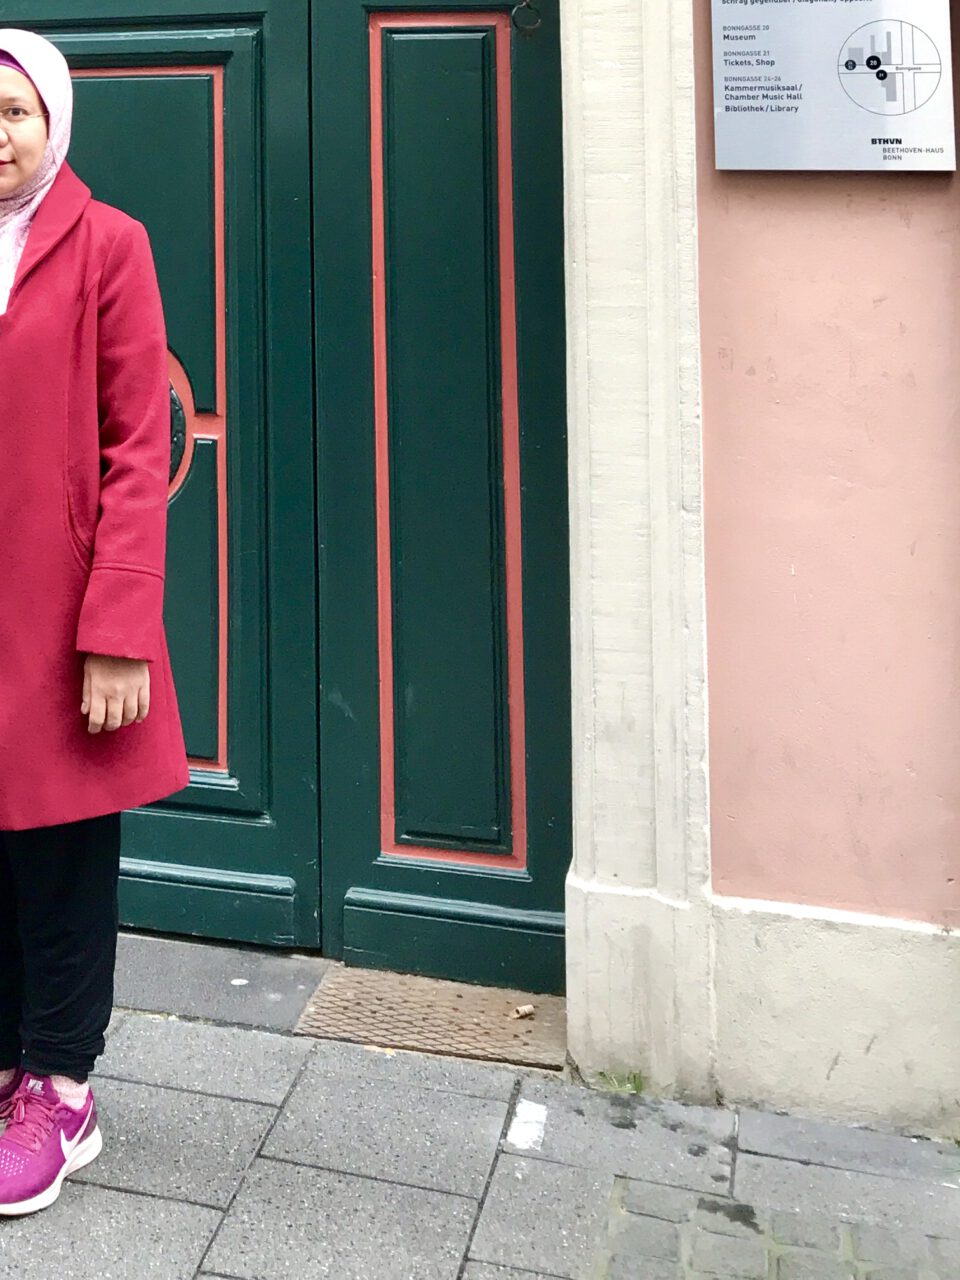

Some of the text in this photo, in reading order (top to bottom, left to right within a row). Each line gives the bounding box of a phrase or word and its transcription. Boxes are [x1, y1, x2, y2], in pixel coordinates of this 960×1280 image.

[724, 93, 760, 101] Chamber
[762, 93, 784, 101] Music
[770, 105, 800, 113] Library
